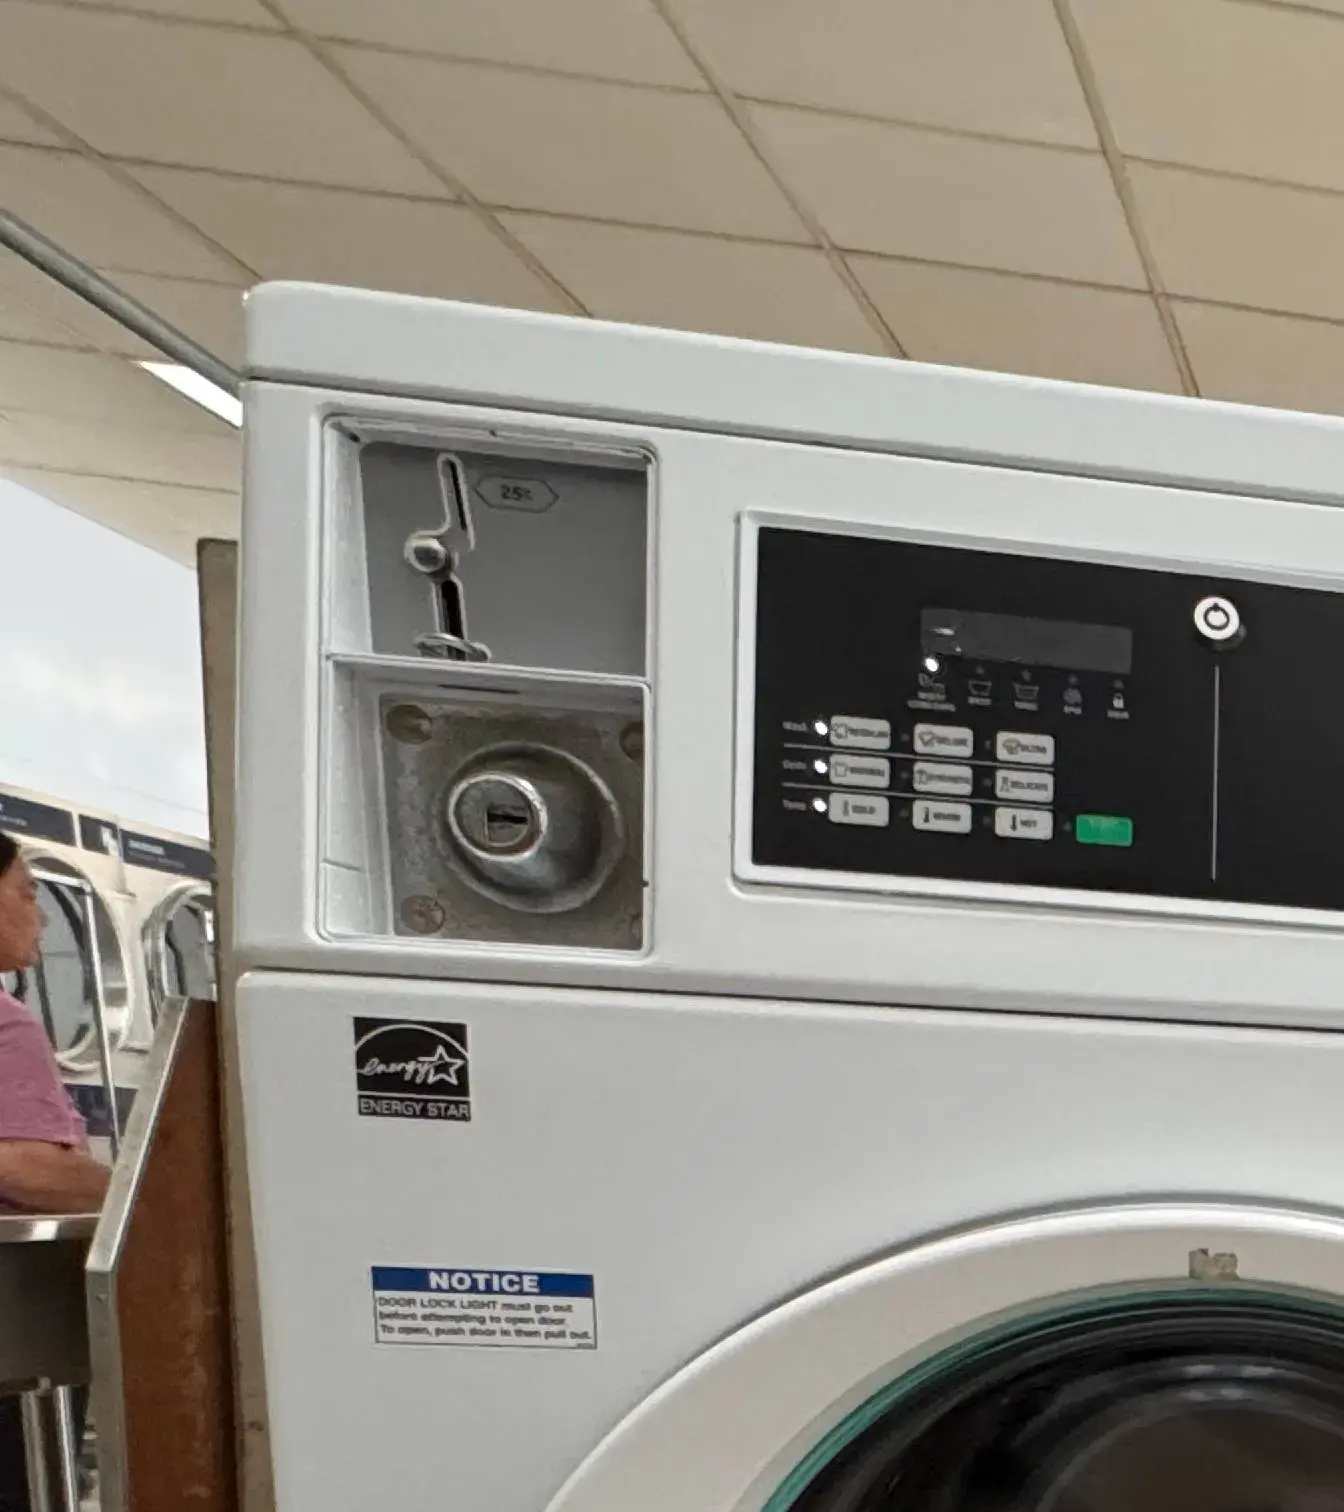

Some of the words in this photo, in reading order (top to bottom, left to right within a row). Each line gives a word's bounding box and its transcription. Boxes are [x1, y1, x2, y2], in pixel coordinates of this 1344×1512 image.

[359, 1098, 424, 1116] ENERGY
[427, 1102, 470, 1118] STAR
[428, 1270, 540, 1293] NOTICE
[420, 1298, 458, 1309] LOCK
[460, 1299, 498, 1311] LIGHT
